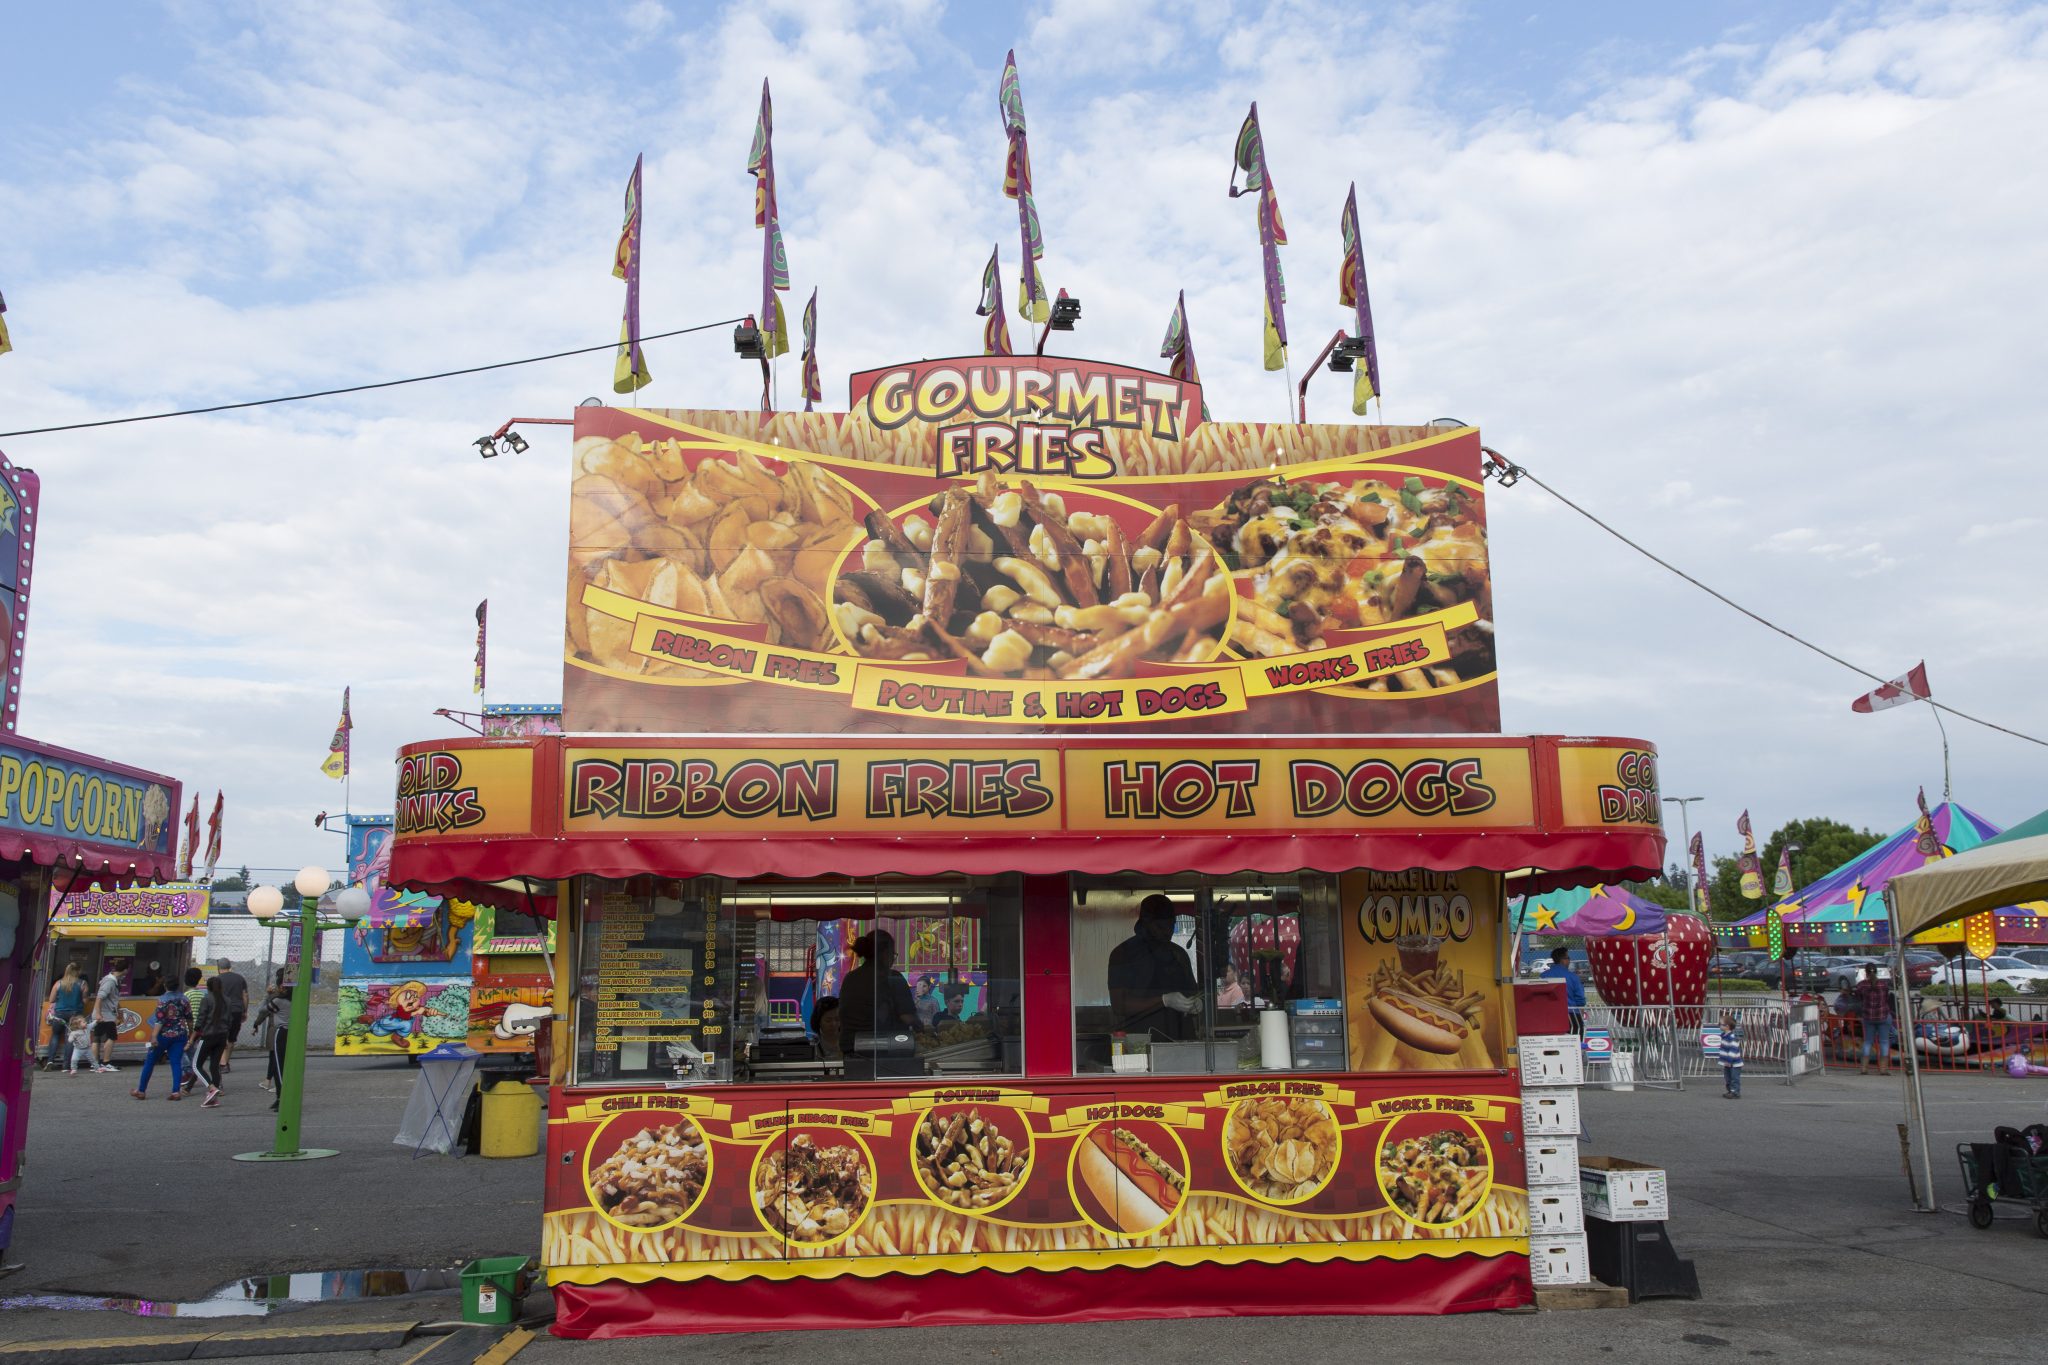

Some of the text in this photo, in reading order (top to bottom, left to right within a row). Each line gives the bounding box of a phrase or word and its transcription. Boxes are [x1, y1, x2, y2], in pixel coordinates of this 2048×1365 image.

[868, 366, 1183, 441] GOURMET
[936, 421, 1116, 479] FRIES
[651, 630, 841, 685] RIBBON FRIES
[1265, 639, 1431, 688] WORKS FRIES
[877, 680, 1228, 719] POUTINE & HOT DOGS
[396, 752, 462, 796] OLD
[1617, 751, 1654, 789] CO
[0, 755, 143, 842] POPCORN
[570, 758, 1055, 822] RIBBON FRIES
[1103, 757, 1497, 819] HOT DOGS
[1368, 868, 1458, 891] MAKE IT A
[64, 890, 189, 917] TICKETS
[1359, 895, 1473, 944] COMBO
[625, 932, 645, 940] GRAVY
[703, 1010, 714, 1018] $10
[597, 1026, 722, 1036] POP $3.50
[602, 1096, 690, 1111] CHILI FRIES
[934, 1090, 1000, 1103] POUTINE
[1226, 1082, 1324, 1098] RIBBON FRIES
[1378, 1098, 1475, 1114] WORKS FRIES
[755, 1114, 870, 1130] DELUXE RIBBON FRIES
[1086, 1105, 1164, 1120] HOT DOGS
